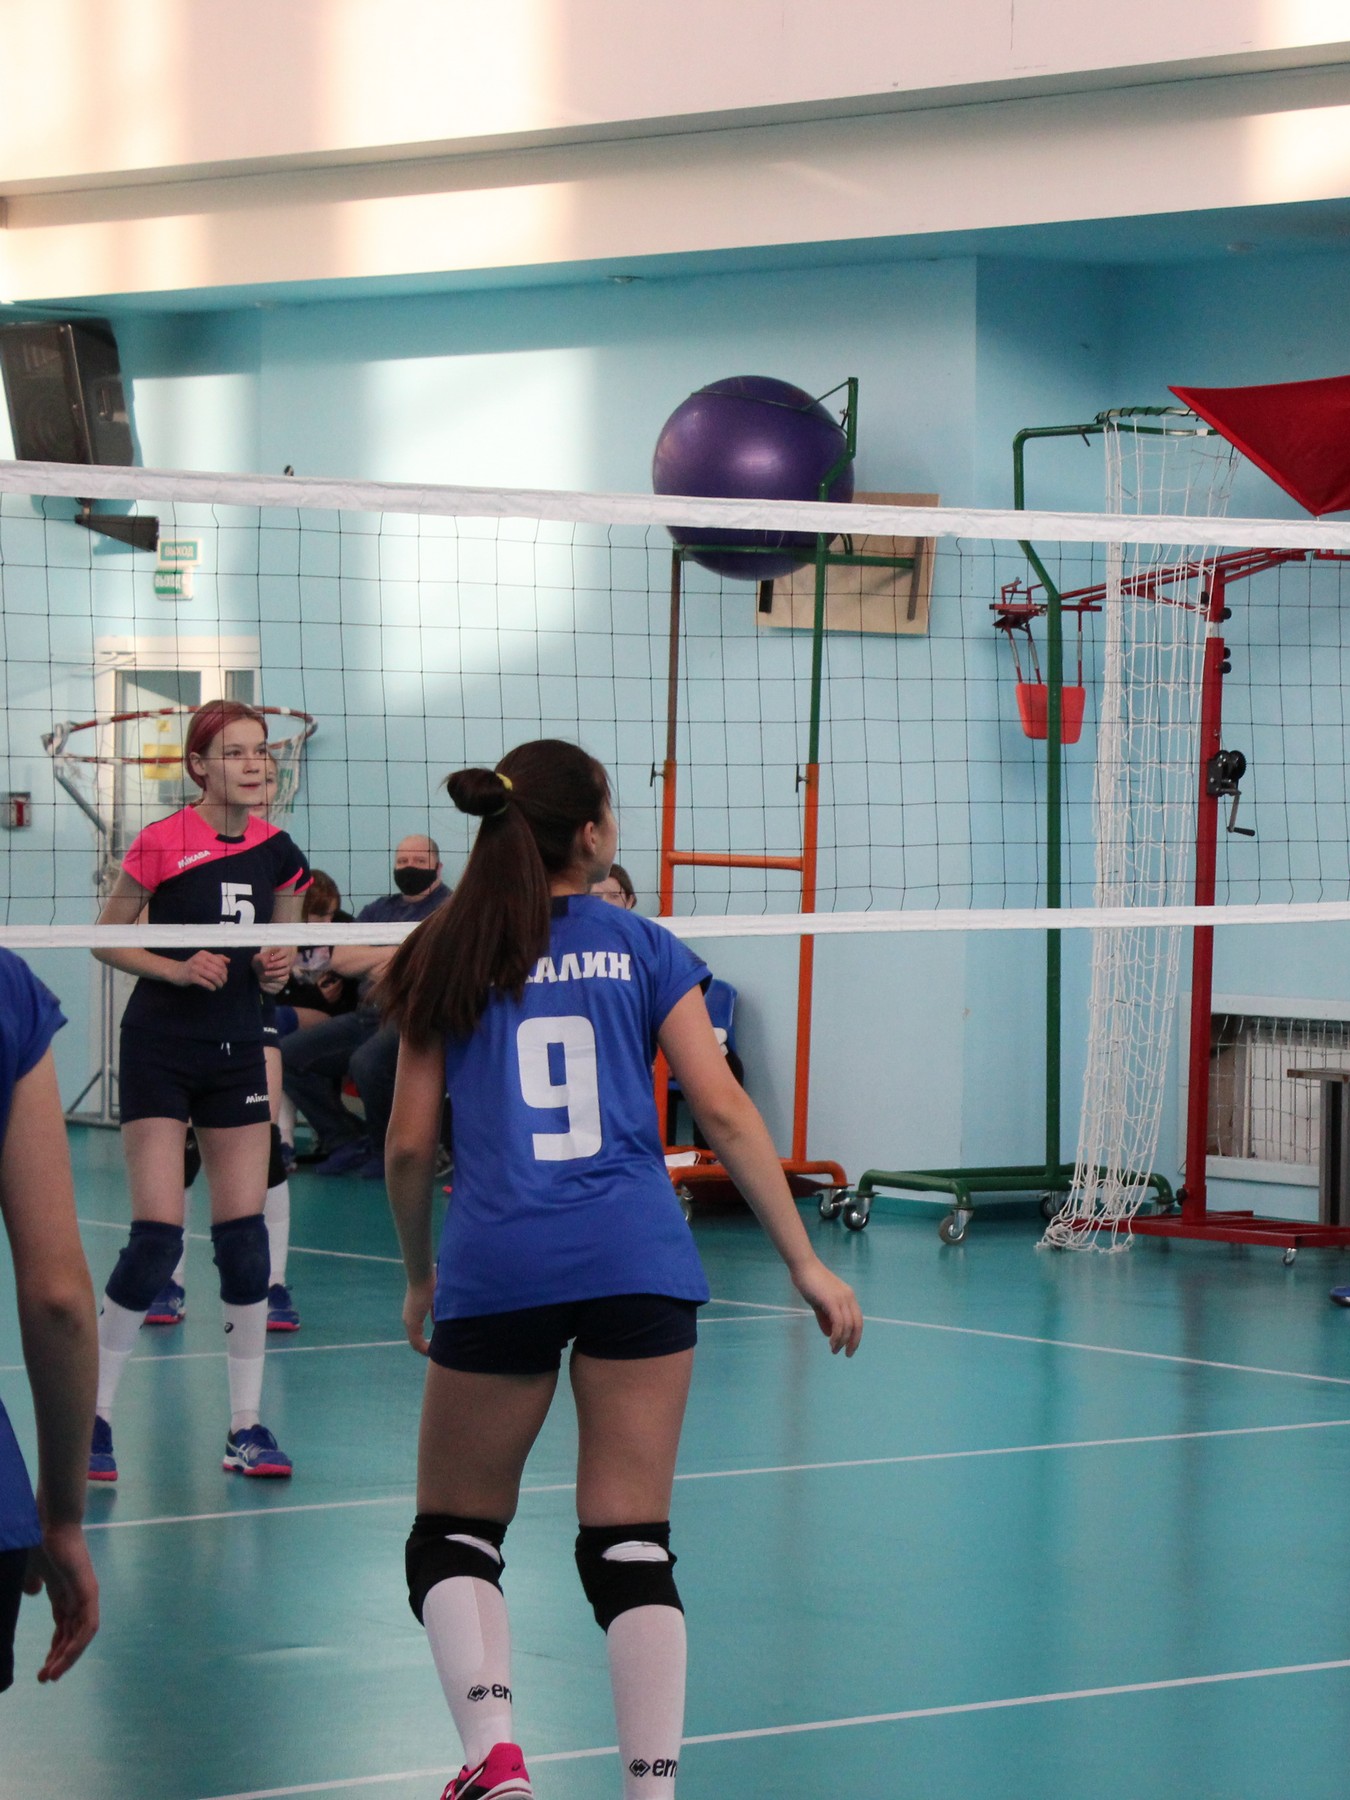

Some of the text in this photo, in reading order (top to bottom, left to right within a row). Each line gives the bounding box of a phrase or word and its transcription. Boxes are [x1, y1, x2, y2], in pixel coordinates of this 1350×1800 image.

[220, 882, 255, 924] 5
[525, 951, 631, 984] АЛИН
[516, 1015, 602, 1162] 9
